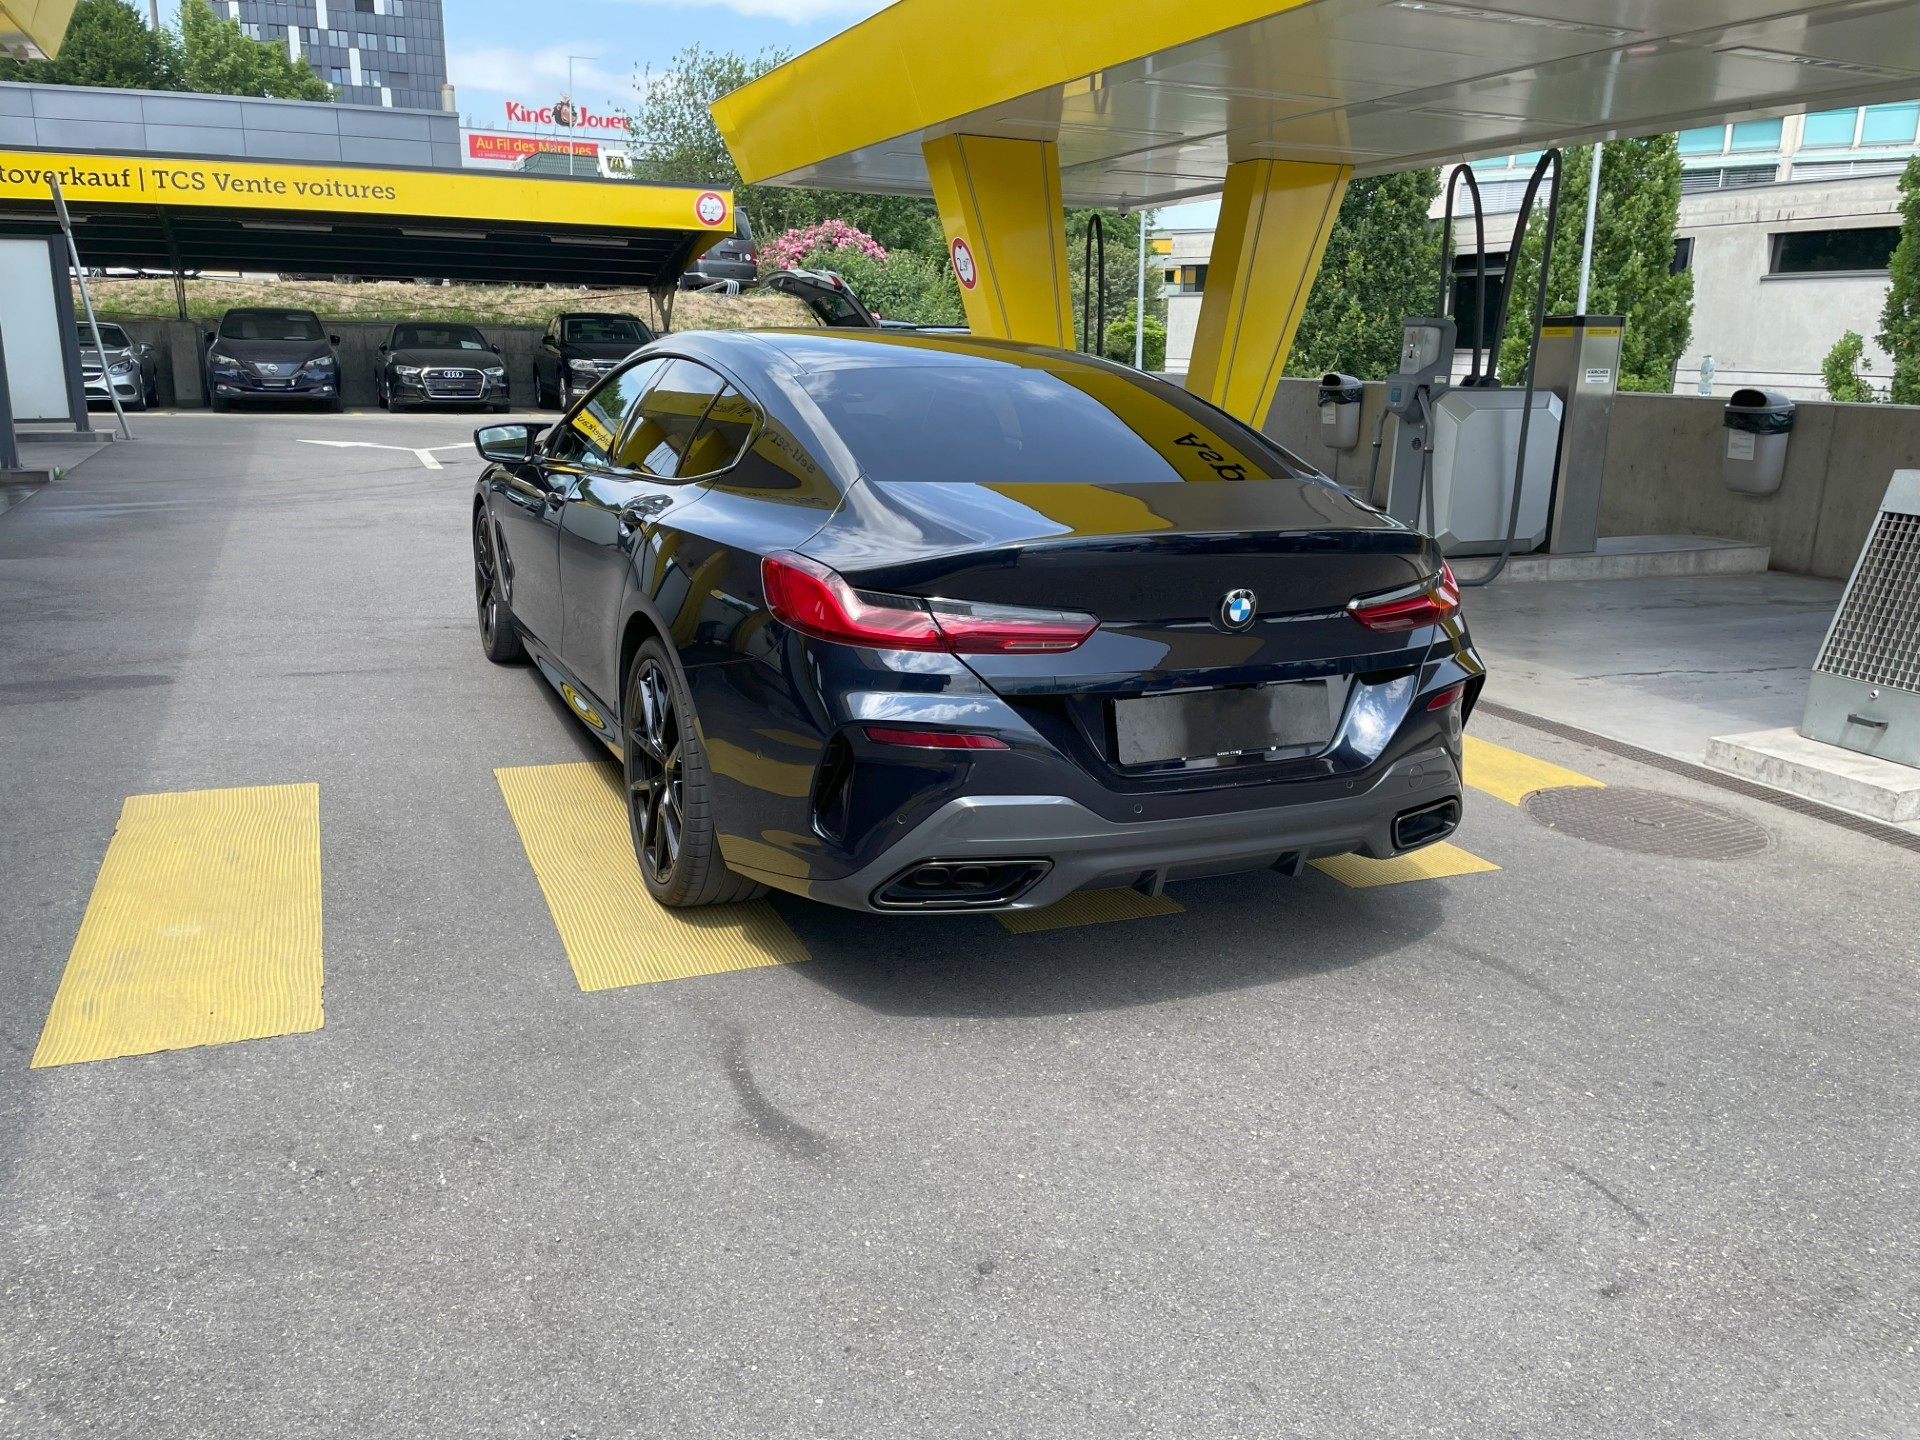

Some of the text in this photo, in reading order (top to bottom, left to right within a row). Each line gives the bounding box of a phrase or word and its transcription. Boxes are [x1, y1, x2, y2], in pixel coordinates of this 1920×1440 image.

[576, 107, 630, 130] Jouet
[475, 137, 493, 150] Au
[496, 138, 510, 151] Fil
[513, 141, 536, 153] des
[152, 170, 206, 191] TCS
[212, 173, 287, 195] Vente
[294, 180, 397, 200] voitures
[1227, 590, 1255, 604] BMW
